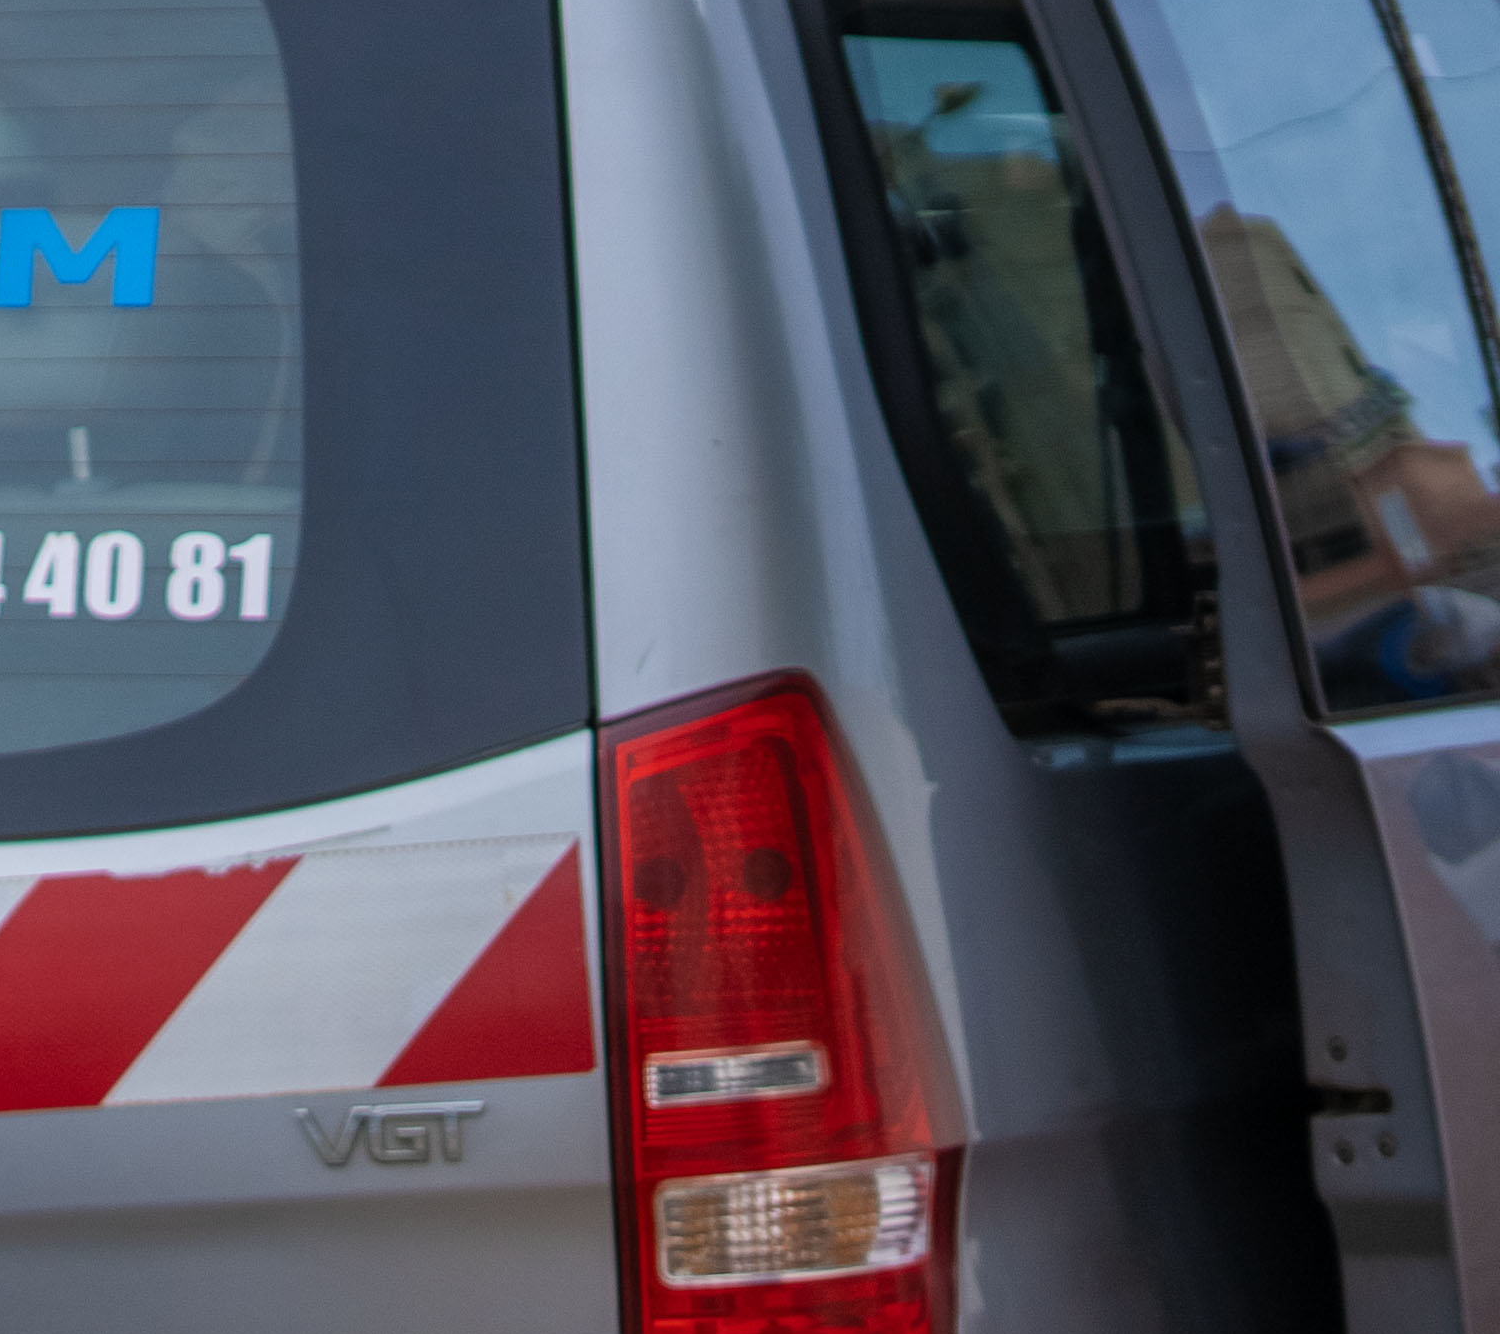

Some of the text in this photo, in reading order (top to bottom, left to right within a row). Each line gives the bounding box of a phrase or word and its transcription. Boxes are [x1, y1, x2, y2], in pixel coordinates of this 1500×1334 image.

[22, 529, 145, 621] 40
[166, 530, 273, 621] 81
[294, 1099, 485, 1168] VGT
